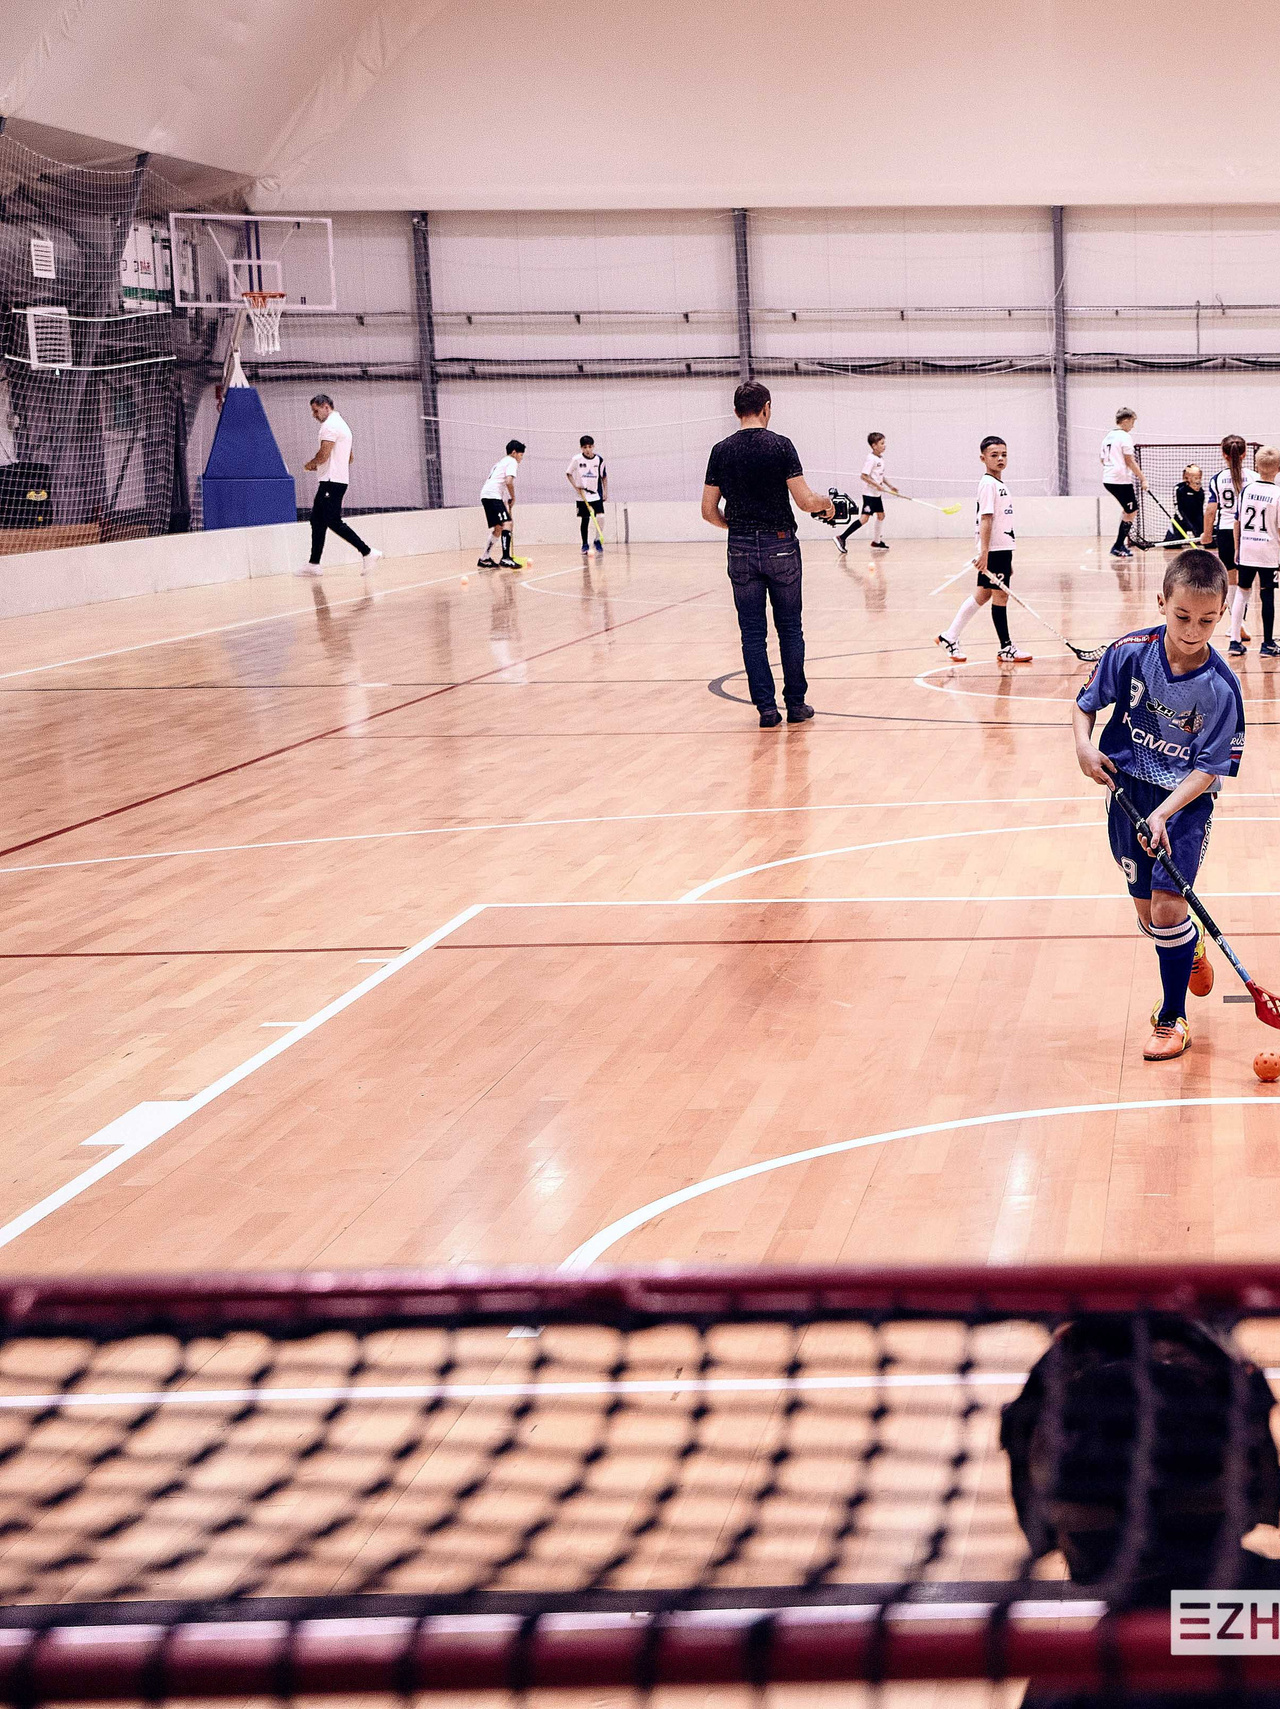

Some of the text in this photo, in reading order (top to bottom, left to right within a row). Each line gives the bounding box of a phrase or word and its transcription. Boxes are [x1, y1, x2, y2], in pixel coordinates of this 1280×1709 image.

[1222, 488, 1235, 509] 9
[1244, 505, 1268, 534] 21
[1129, 676, 1146, 710] 9
[1121, 711, 1191, 762] КСМОС
[1120, 856, 1138, 885] 9
